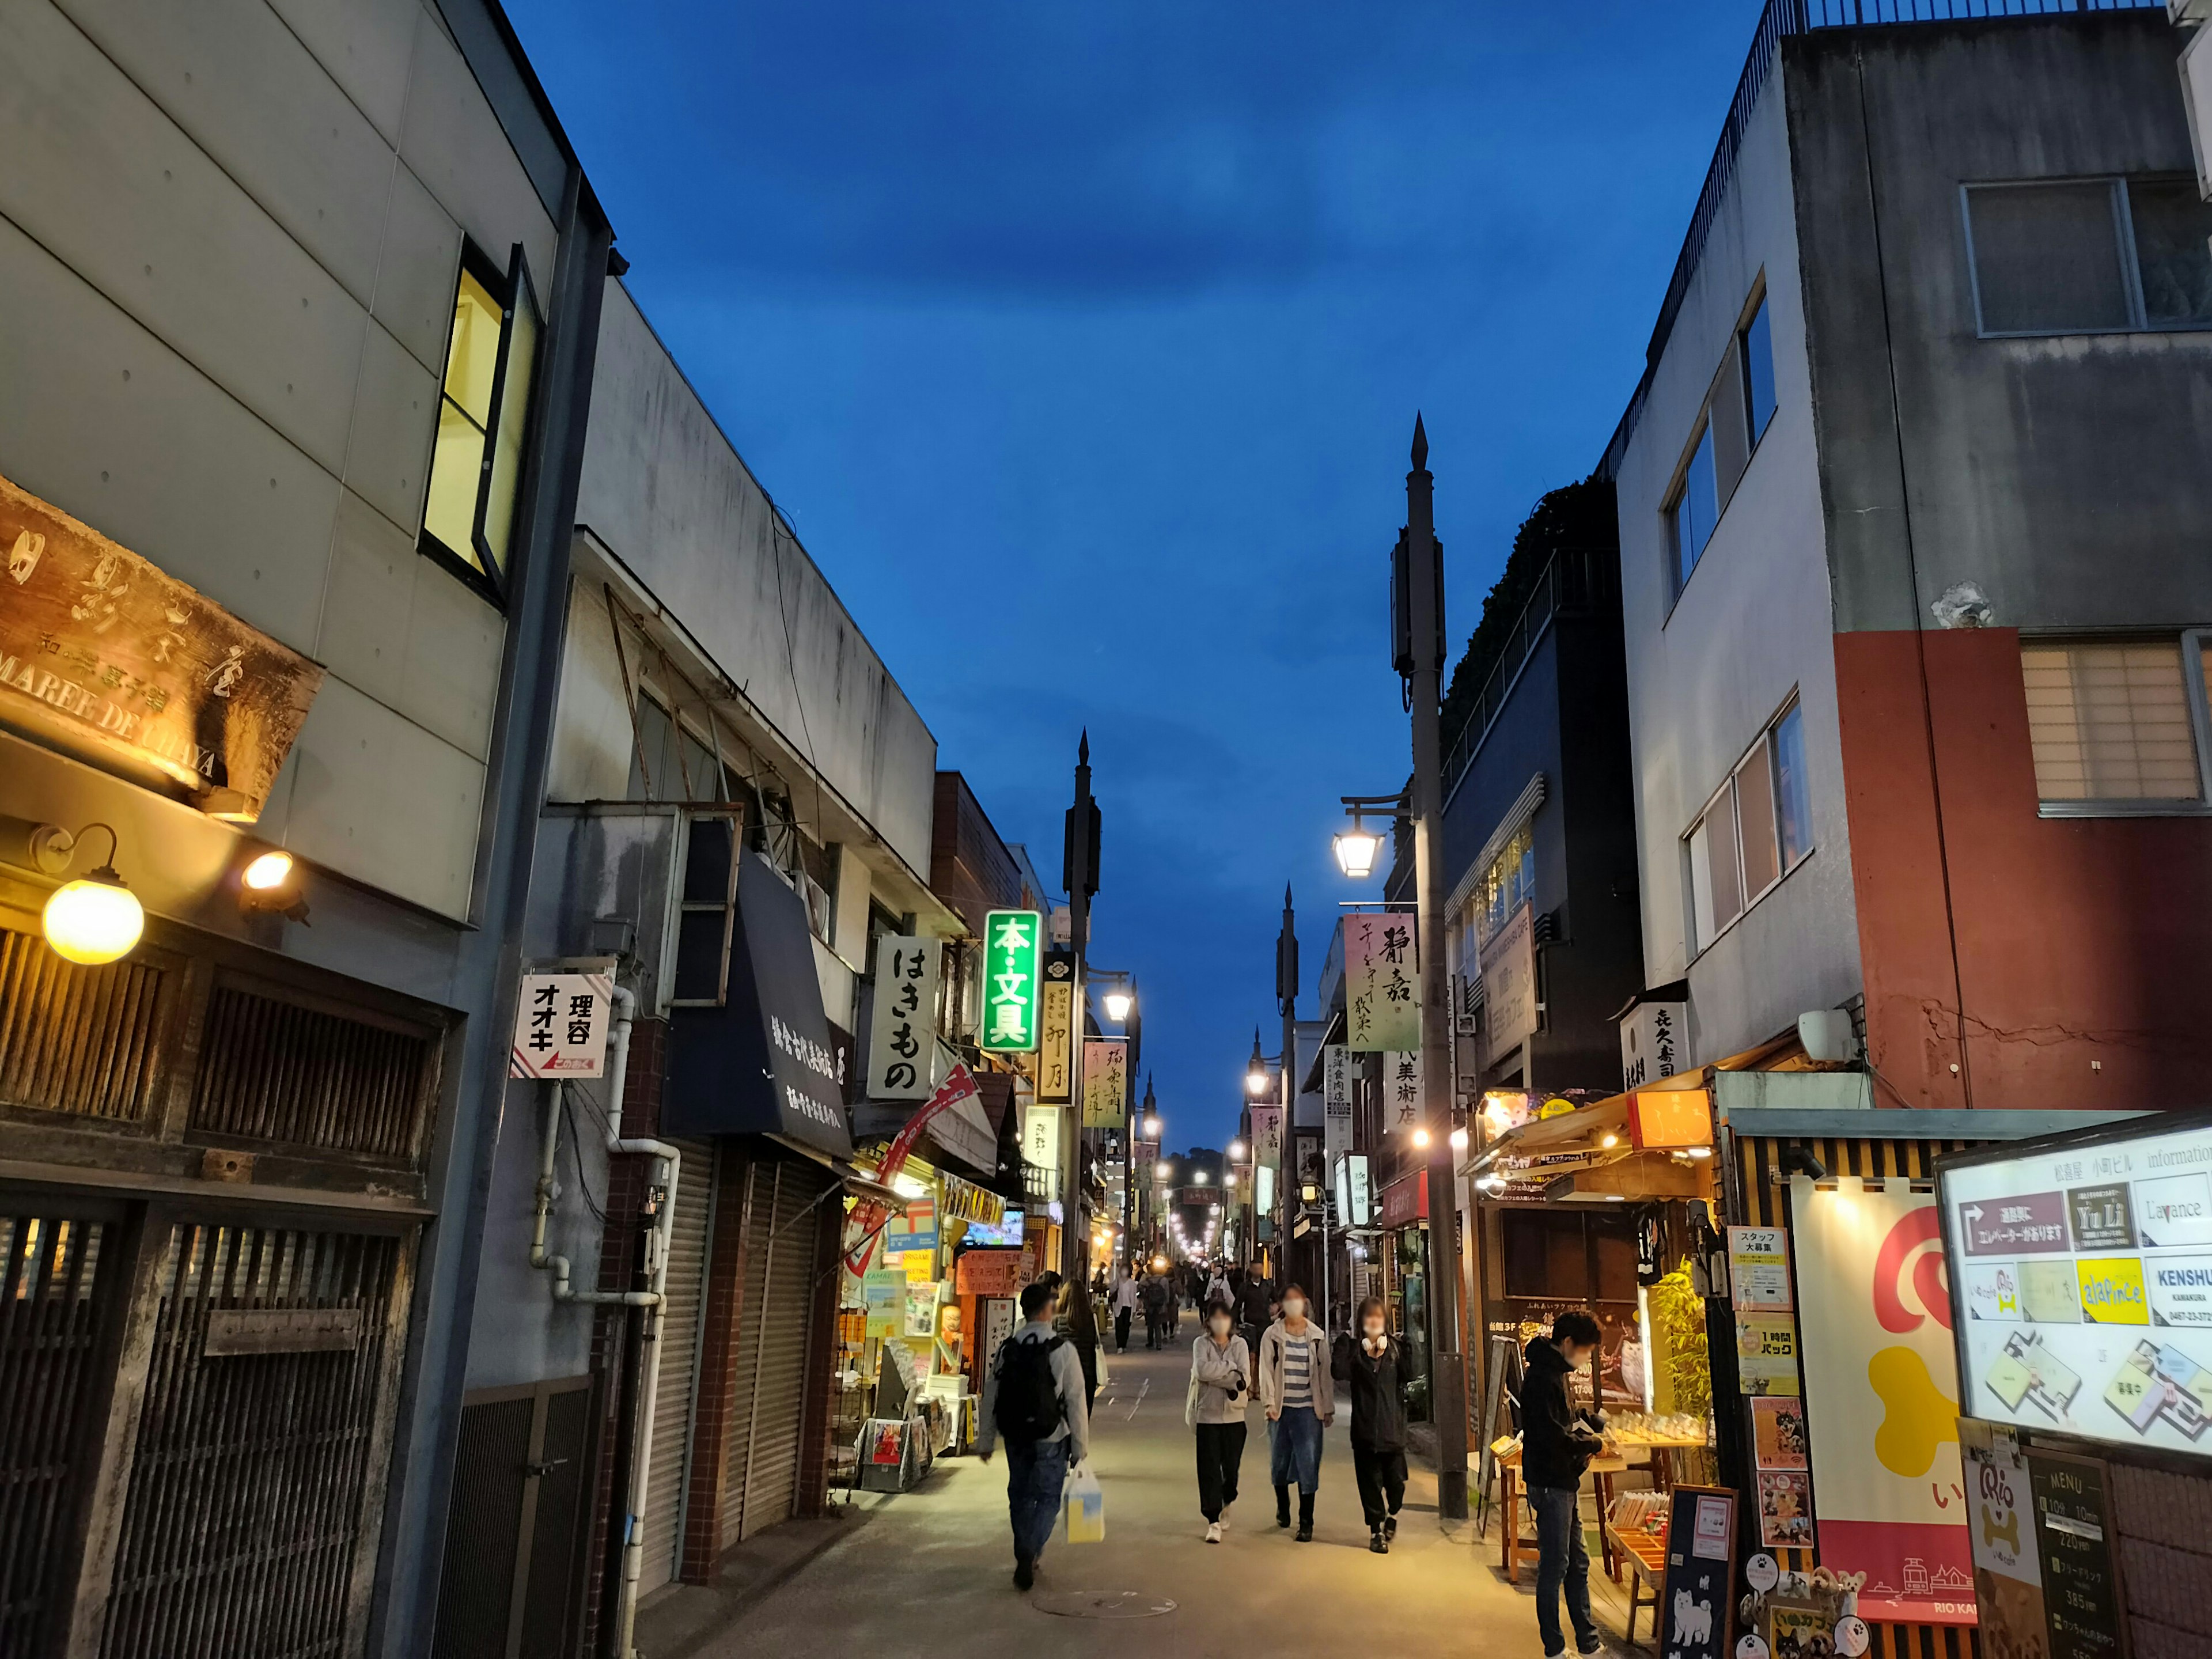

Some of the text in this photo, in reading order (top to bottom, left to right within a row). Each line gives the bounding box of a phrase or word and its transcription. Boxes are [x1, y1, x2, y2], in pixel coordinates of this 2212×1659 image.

[97, 700, 141, 740] DE
[990, 916, 1031, 1044] 本・文具
[529, 984, 560, 1052] オオキ
[567, 995, 594, 1044] 理容
[884, 948, 926, 1089] はきもの
[1333, 1047, 1345, 1102] 東洋食肉店
[2093, 1154, 2133, 1178] 小町ビル
[2077, 1202, 2126, 1230] Yu Li
[1741, 1232, 1775, 1241] スタッフ
[1978, 1223, 2063, 1244] エレベーターがあります
[1746, 1243, 1772, 1252] 大募集
[1761, 1344, 1791, 1355] パック
[1762, 1332, 1791, 1343] 1時間
[1980, 1463, 2014, 1509] Rio
[2051, 1472, 2082, 1494] MENU
[2049, 1499, 2099, 1524] 10分 10min
[2060, 1562, 2101, 1584] フリードリンク
[1934, 1603, 1955, 1613] RIO
[2066, 1590, 2097, 1612] 385yen
